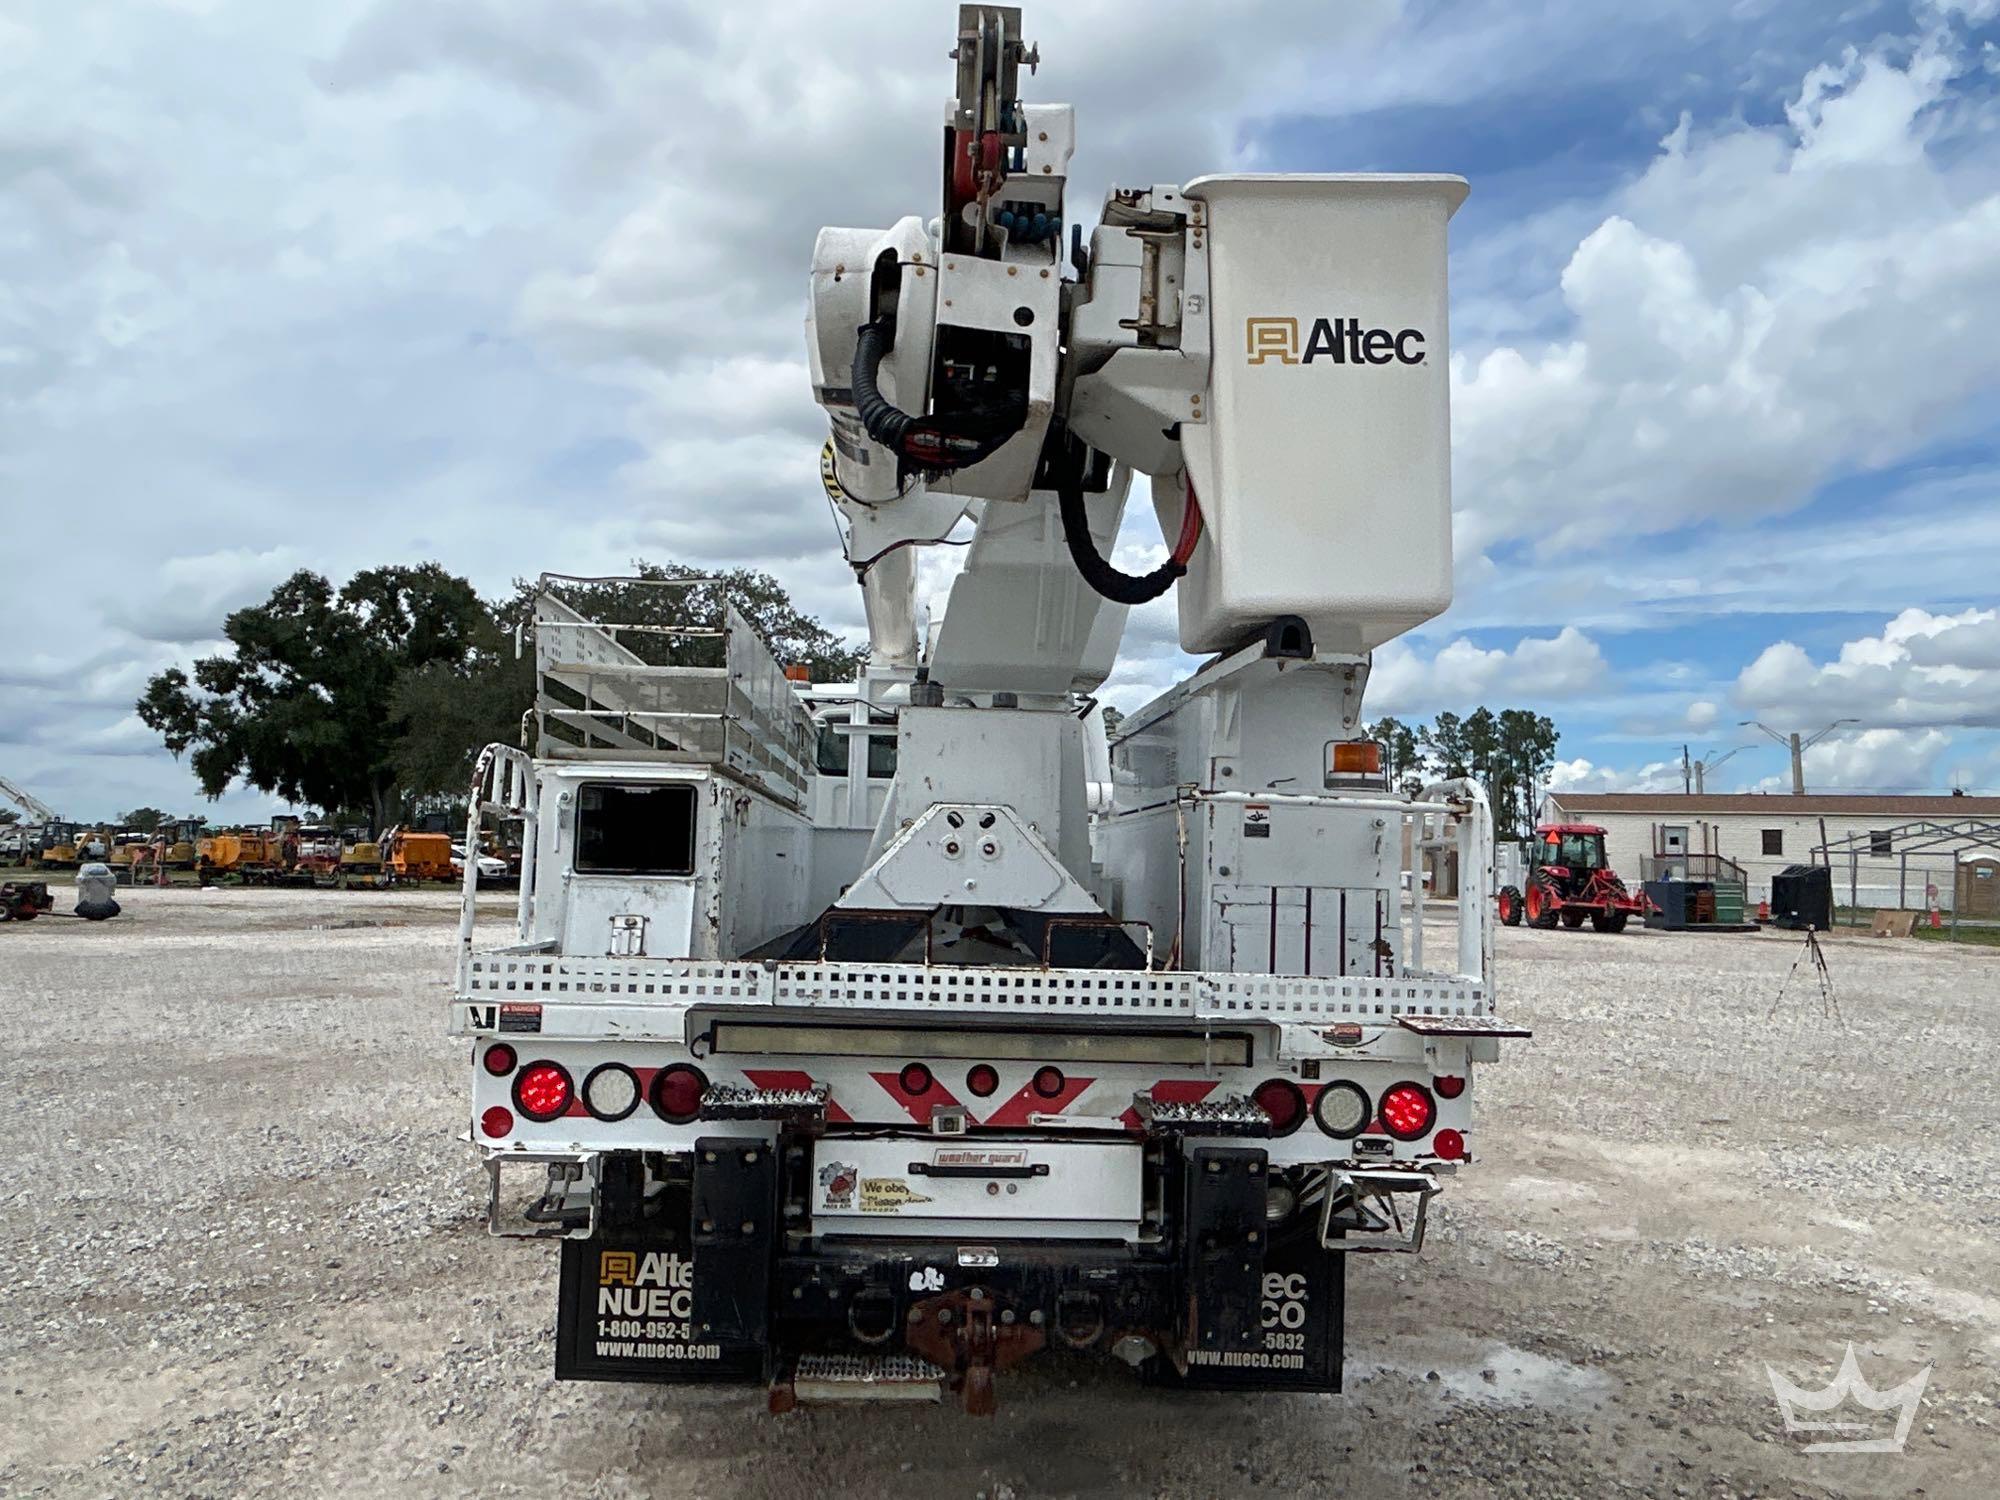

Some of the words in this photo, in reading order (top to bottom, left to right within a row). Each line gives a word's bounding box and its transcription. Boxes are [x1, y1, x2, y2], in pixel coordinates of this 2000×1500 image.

[1302, 318, 1426, 365] Altec
[938, 1151, 986, 1163] weather
[988, 1152, 1023, 1164] guard
[864, 1182, 882, 1193] We
[635, 1252, 694, 1288] Alte
[598, 1287, 692, 1318] NUEC
[597, 1320, 690, 1340] 1-800-952-5
[596, 1341, 721, 1360] www.nueco.com
